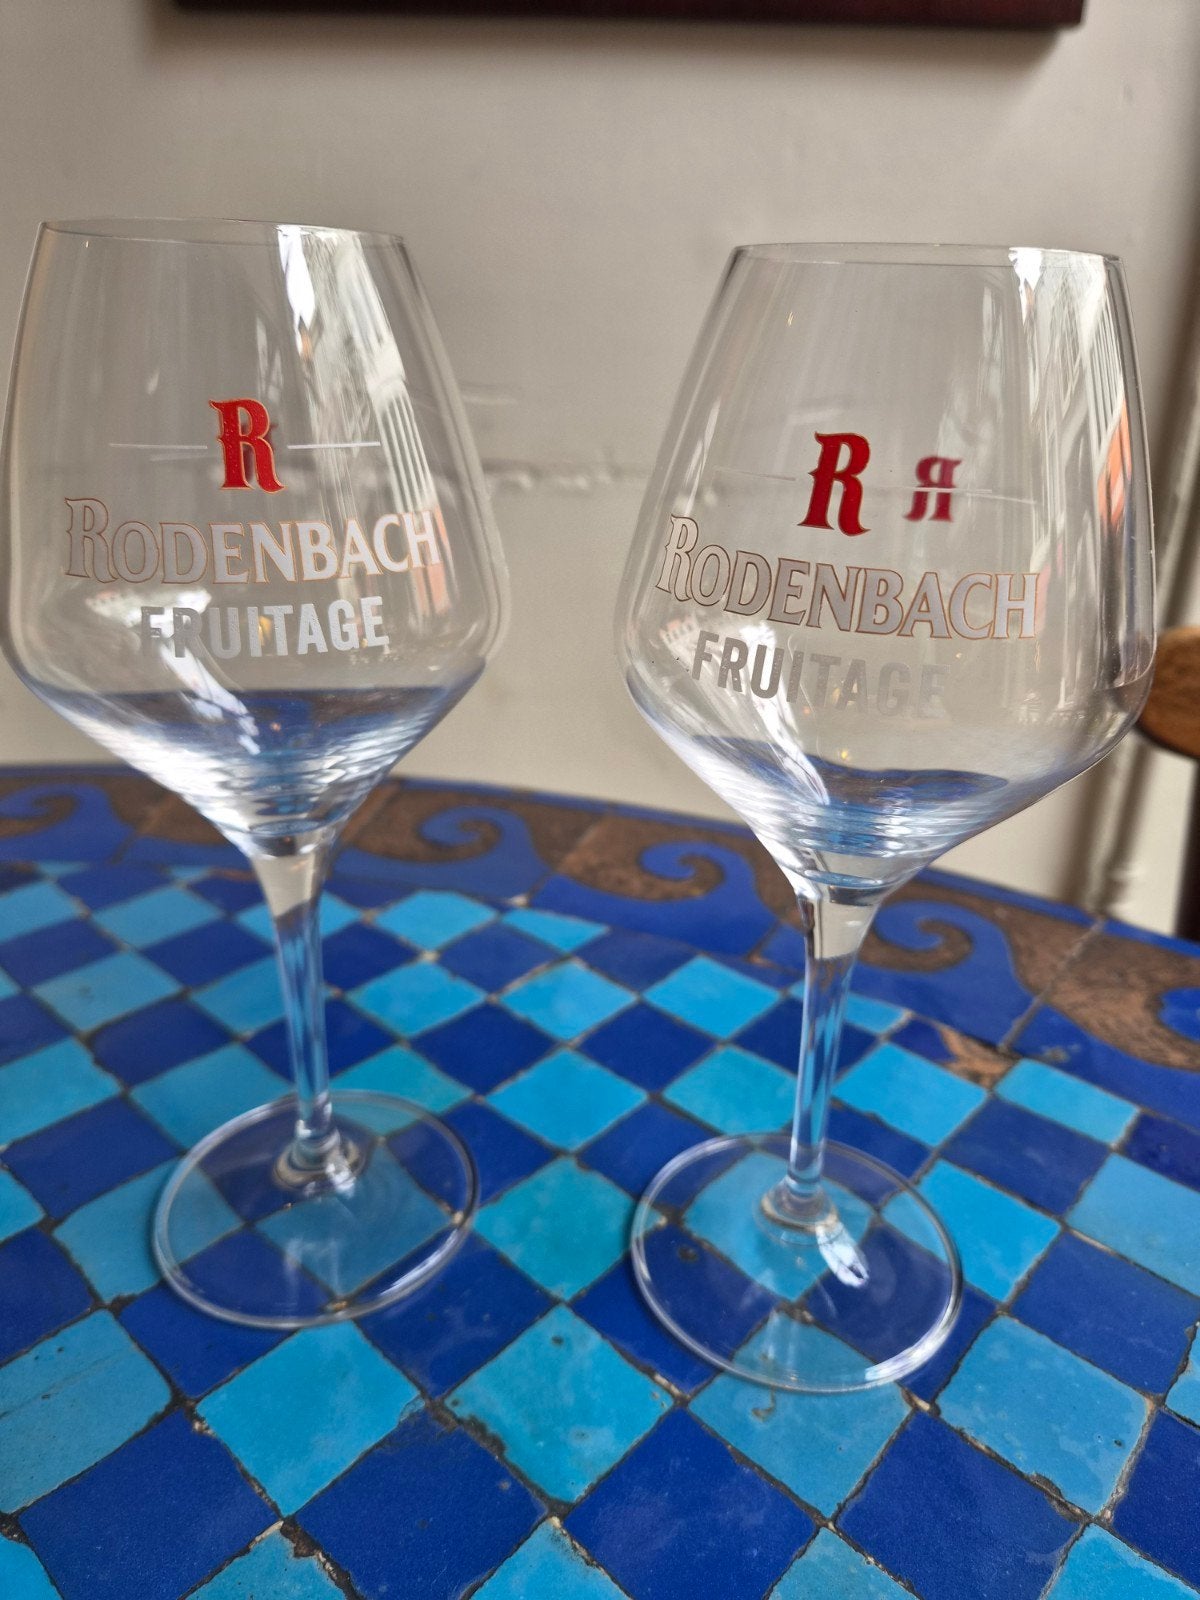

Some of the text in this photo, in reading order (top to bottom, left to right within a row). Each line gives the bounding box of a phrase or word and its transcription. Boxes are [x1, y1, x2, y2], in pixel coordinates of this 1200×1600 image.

[209, 398, 285, 493] R
[797, 431, 871, 537] R
[65, 497, 442, 584] RODENBACH
[655, 514, 1041, 641] RODENBACH
[141, 595, 390, 660] FRUITAGE
[691, 630, 952, 720] FRUITAGE
